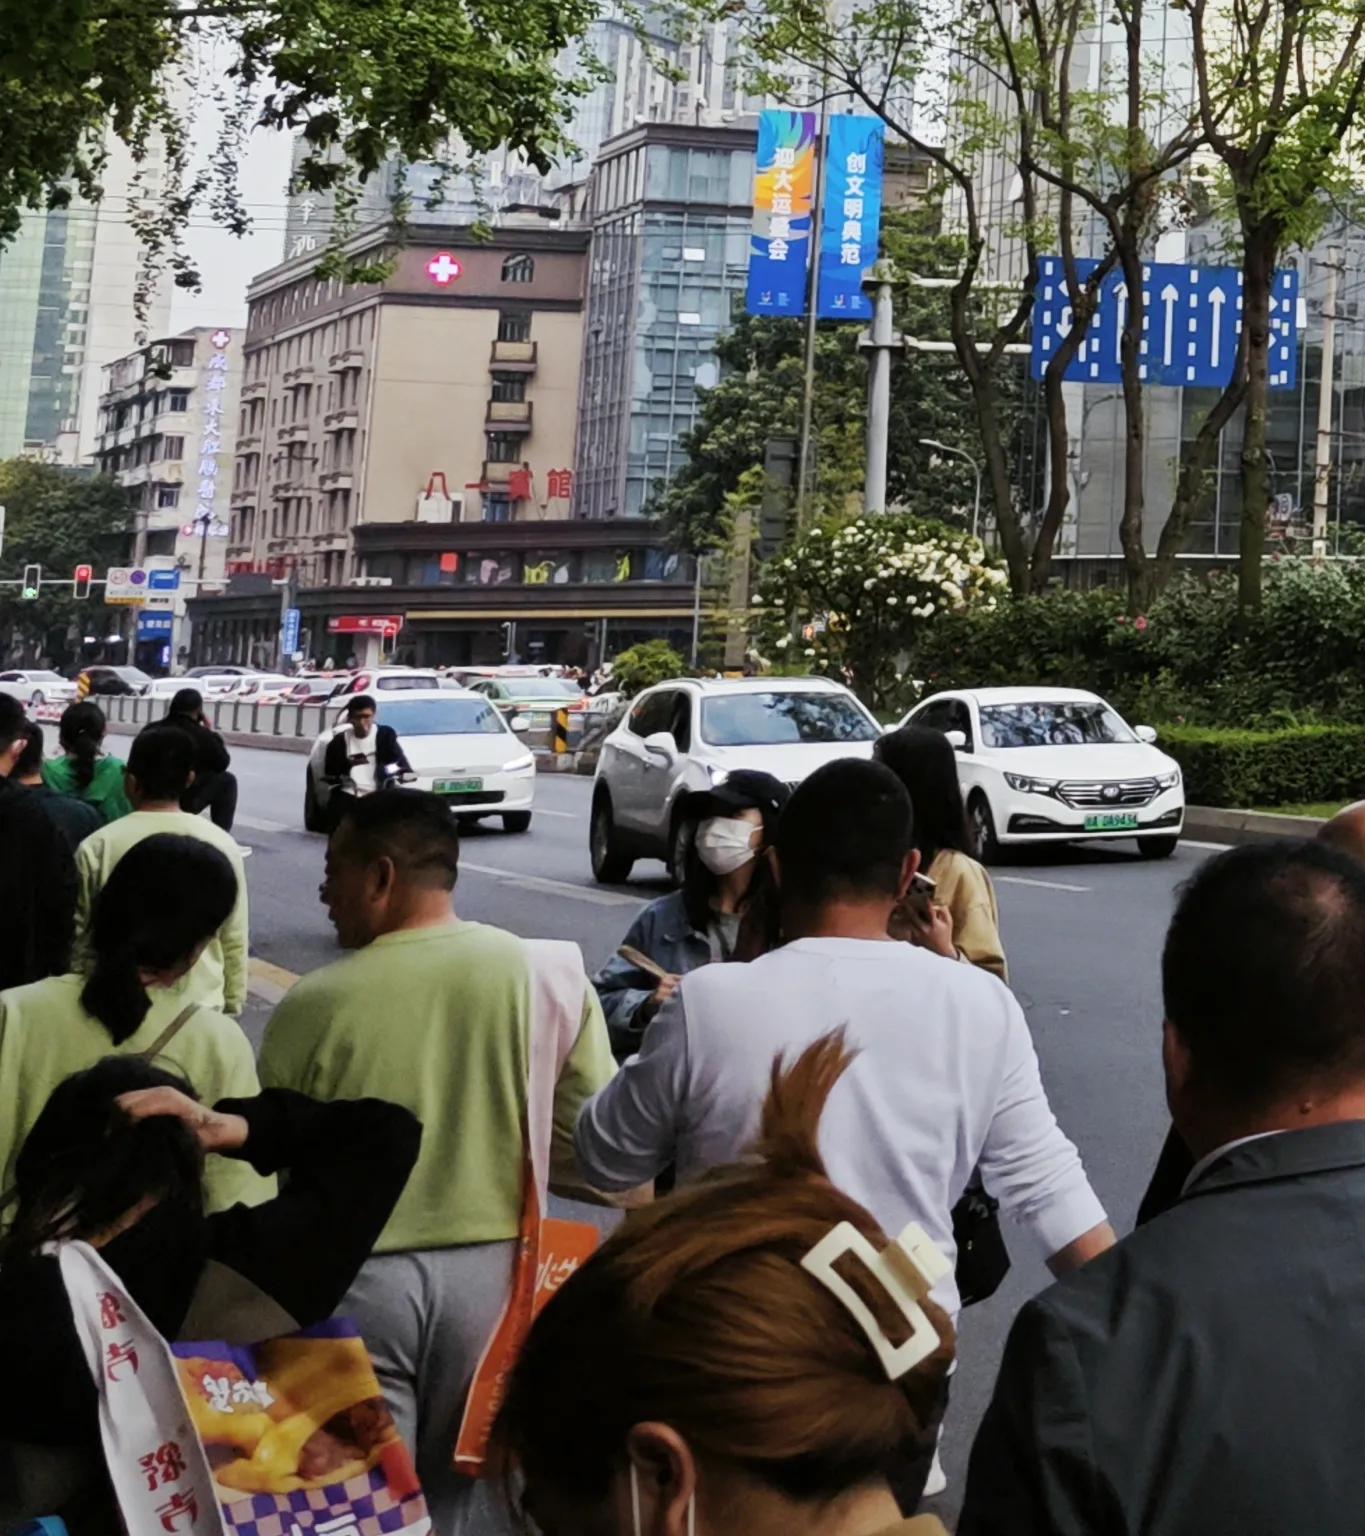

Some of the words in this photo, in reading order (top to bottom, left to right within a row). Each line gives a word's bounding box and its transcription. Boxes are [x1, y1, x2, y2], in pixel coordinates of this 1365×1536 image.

[840, 151, 868, 265] 创文明典范
